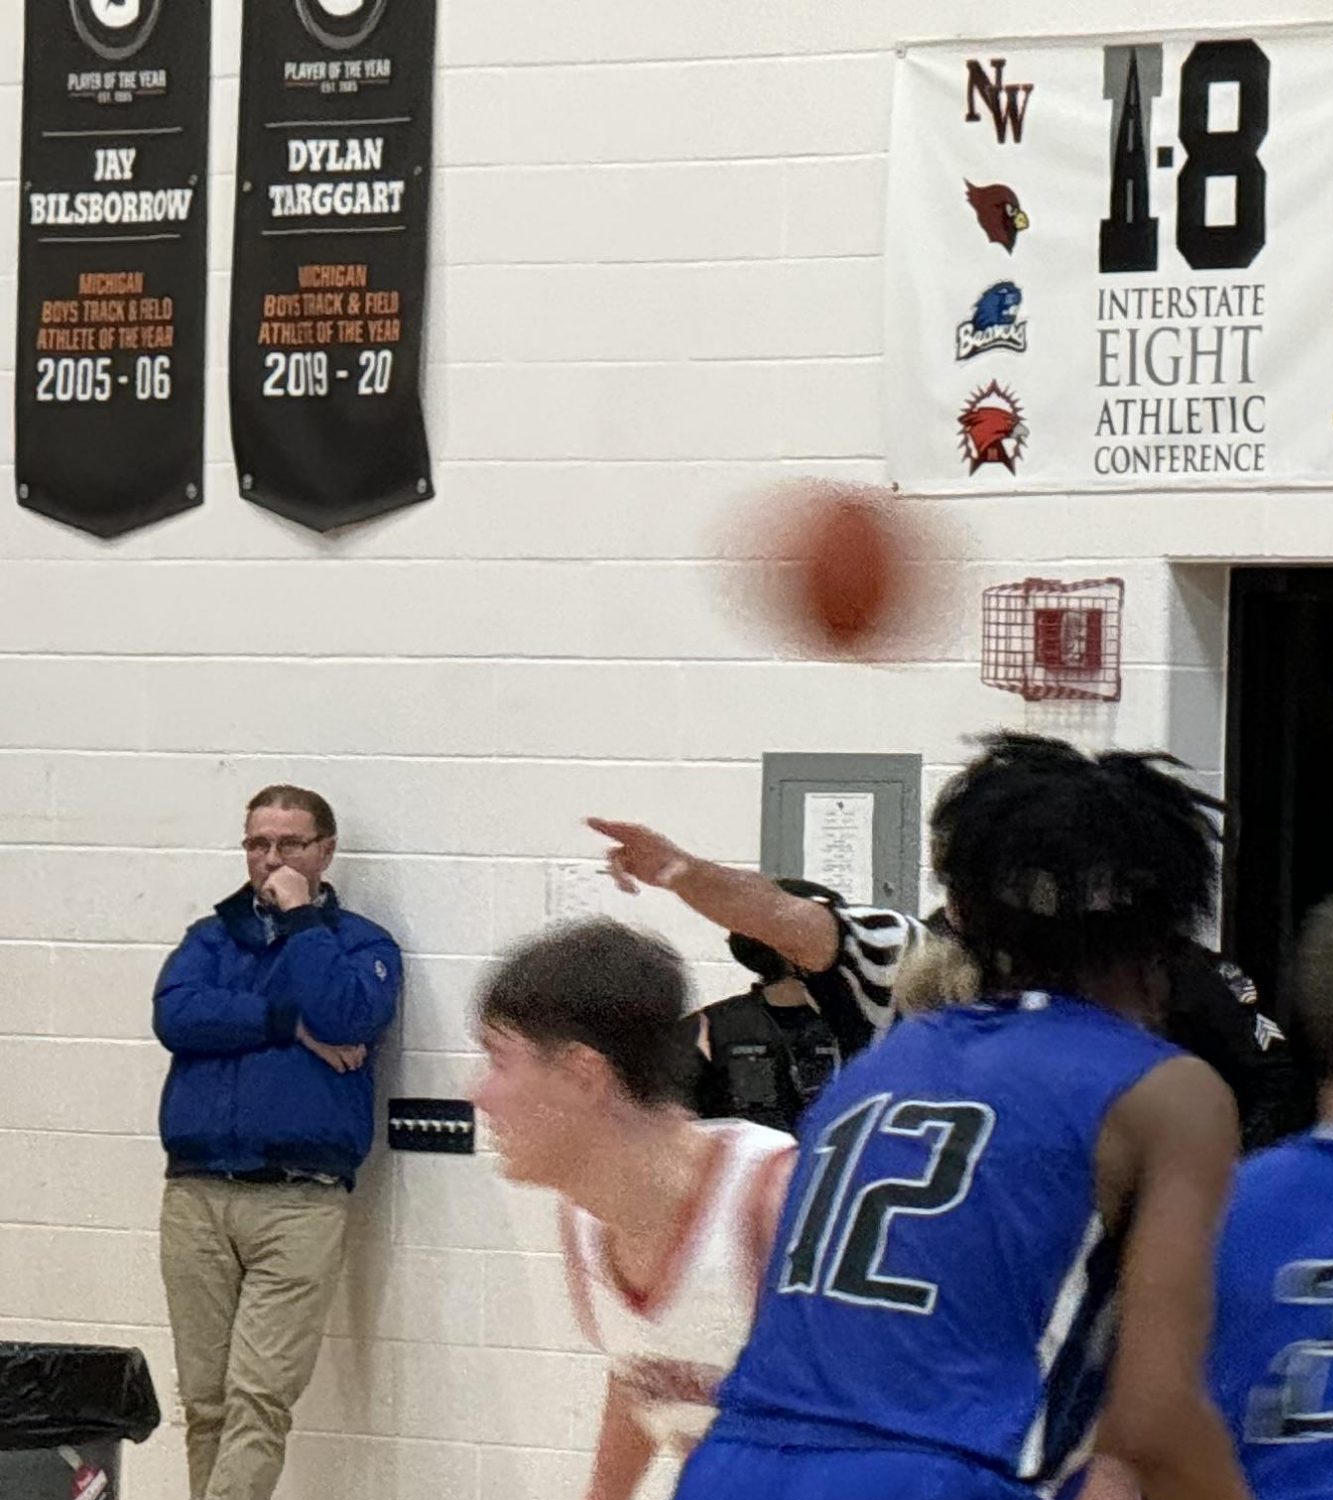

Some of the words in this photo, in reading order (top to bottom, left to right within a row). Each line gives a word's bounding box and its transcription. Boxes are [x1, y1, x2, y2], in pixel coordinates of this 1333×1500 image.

[67, 72, 102, 91] PLAYER
[138, 68, 167, 88] YEAR
[284, 61, 326, 81] PLAYER
[328, 61, 342, 80] OF
[343, 60, 362, 79] THE
[363, 58, 391, 78] YEAR
[965, 59, 1034, 144] NW
[94, 148, 136, 181] JAY
[287, 137, 384, 172] DYLAN
[30, 188, 193, 225] BILSBORROW
[269, 180, 405, 217] TARGGART
[79, 271, 144, 295] MICHIGAN
[297, 264, 367, 288] MICHIGAN
[41, 300, 79, 323] BOYS
[83, 299, 125, 322] TRACK
[127, 299, 138, 322] &
[140, 296, 173, 321] FIELD
[263, 294, 300, 318] BOYS
[302, 292, 343, 316] TRACK
[347, 292, 361, 316] &
[364, 290, 399, 315] FIELD
[1098, 284, 1266, 321] INTERSTATE
[36, 327, 96, 351] ATHLETE
[98, 326, 116, 350] OF
[118, 326, 139, 349] THE
[140, 325, 174, 349] YEAR
[257, 321, 314, 345] ATHLETE
[316, 320, 334, 344] OF
[336, 319, 364, 343] THE
[366, 318, 400, 342] YEAR
[263, 351, 328, 396] 2019
[358, 349, 393, 395] 20
[1095, 325, 1263, 388] EIGHT
[36, 357, 112, 401] 2005
[135, 354, 171, 400] 06
[1094, 395, 1266, 438] ATHLETIC
[1094, 443, 1266, 476] CONFERENCE
[779, 1092, 996, 1314] 12
